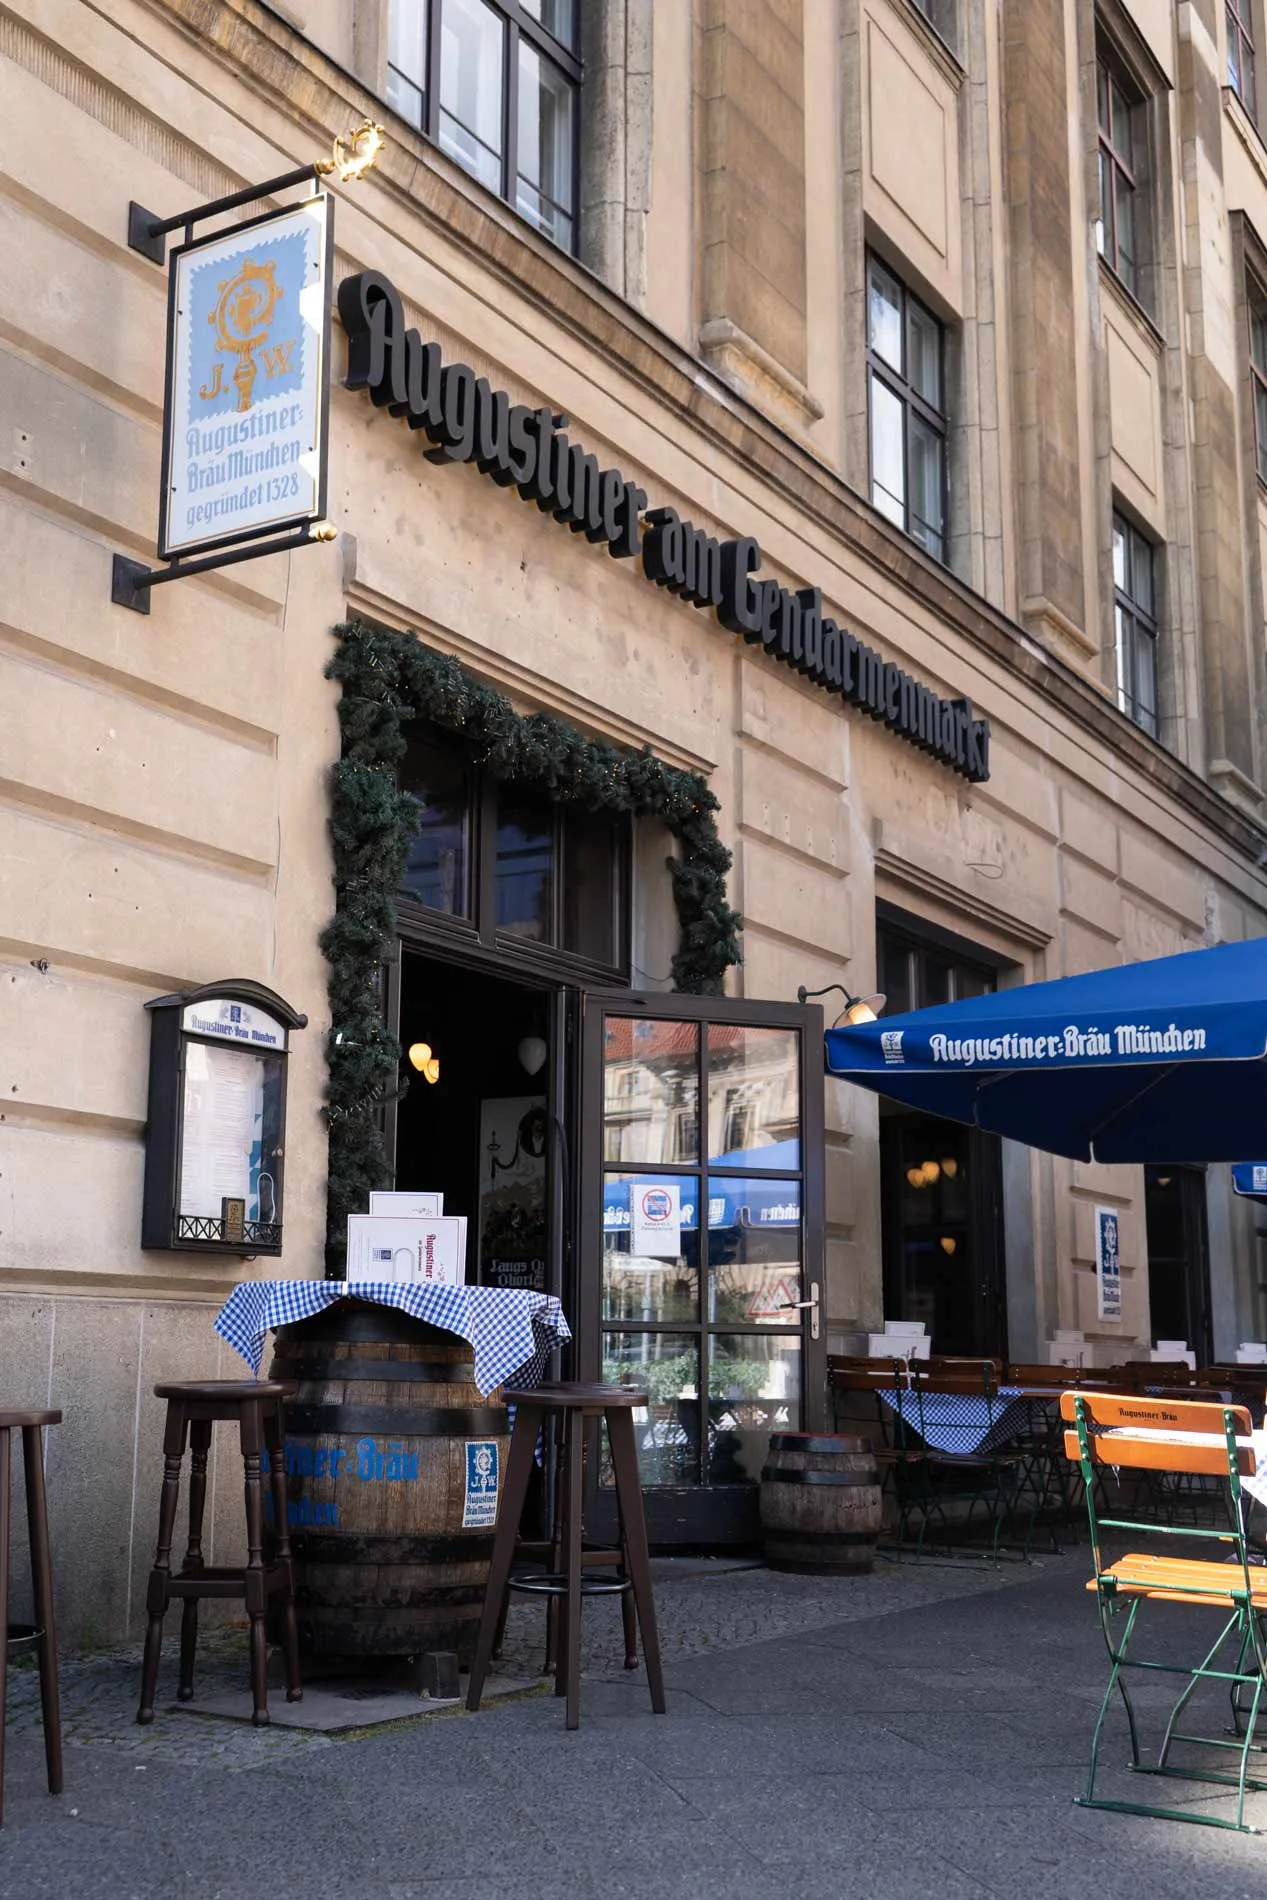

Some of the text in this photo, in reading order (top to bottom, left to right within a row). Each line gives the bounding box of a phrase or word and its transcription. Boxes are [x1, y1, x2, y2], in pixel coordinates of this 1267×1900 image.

[187, 439, 301, 493] Bräu München
[186, 472, 299, 528] gegründet 1328
[340, 269, 991, 783] Augustiner am Gendarmenmarkt
[1114, 1023, 1206, 1055] München
[425, 1233, 437, 1279] Augustiner
